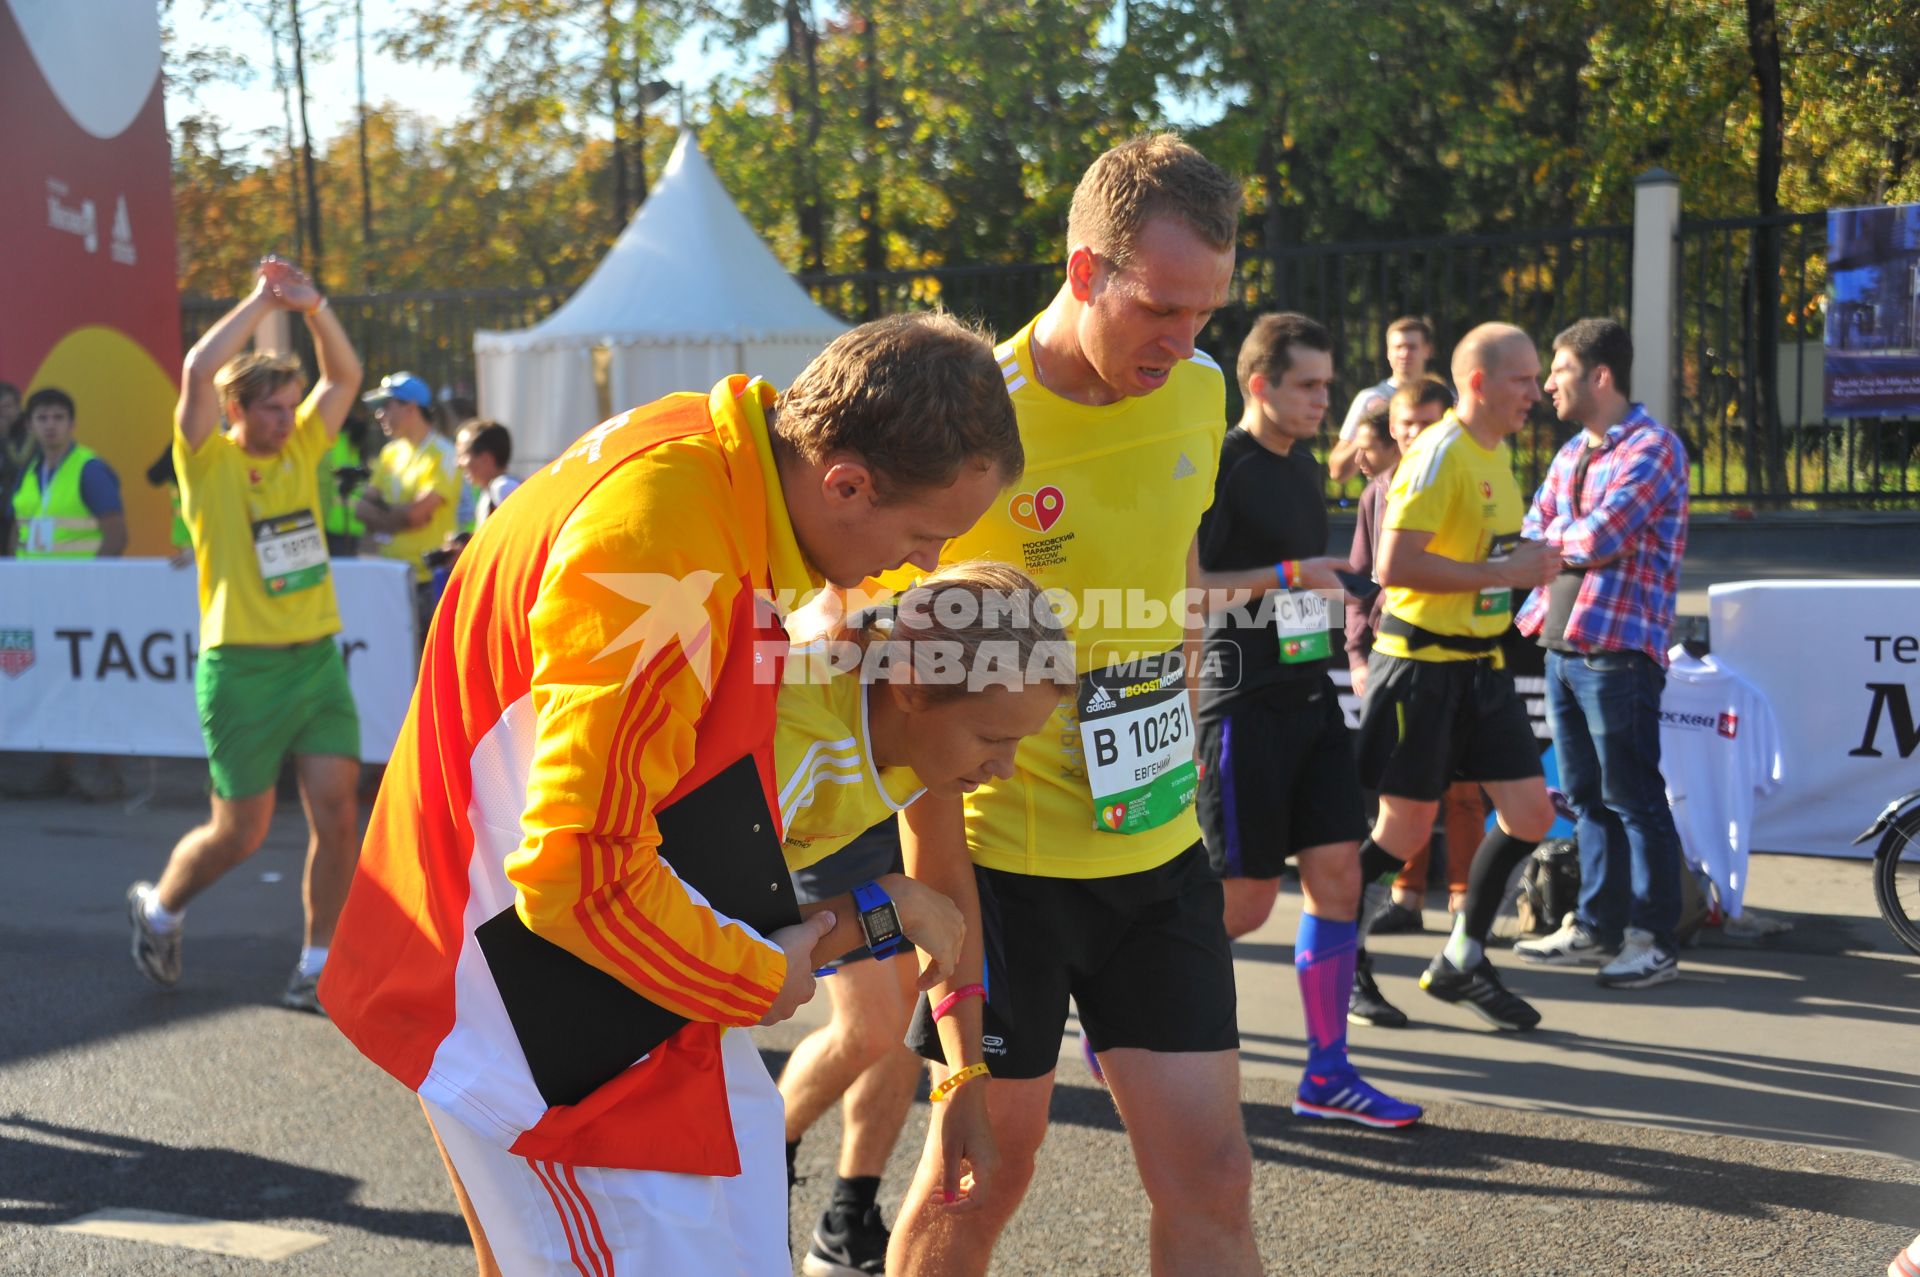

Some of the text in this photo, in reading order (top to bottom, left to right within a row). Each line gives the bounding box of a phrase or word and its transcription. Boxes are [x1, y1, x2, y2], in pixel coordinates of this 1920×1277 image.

[1023, 532, 1075, 549] МОСКОВСКИЙ
[1024, 544, 1062, 556] МАРАФОН
[1025, 552, 1058, 562] MOSCOW
[1026, 557, 1067, 568] MARATHON
[1086, 699, 1117, 714] adidas
[1093, 702, 1189, 768] B 10231
[1134, 754, 1171, 781] ЕВГЕНИЙ
